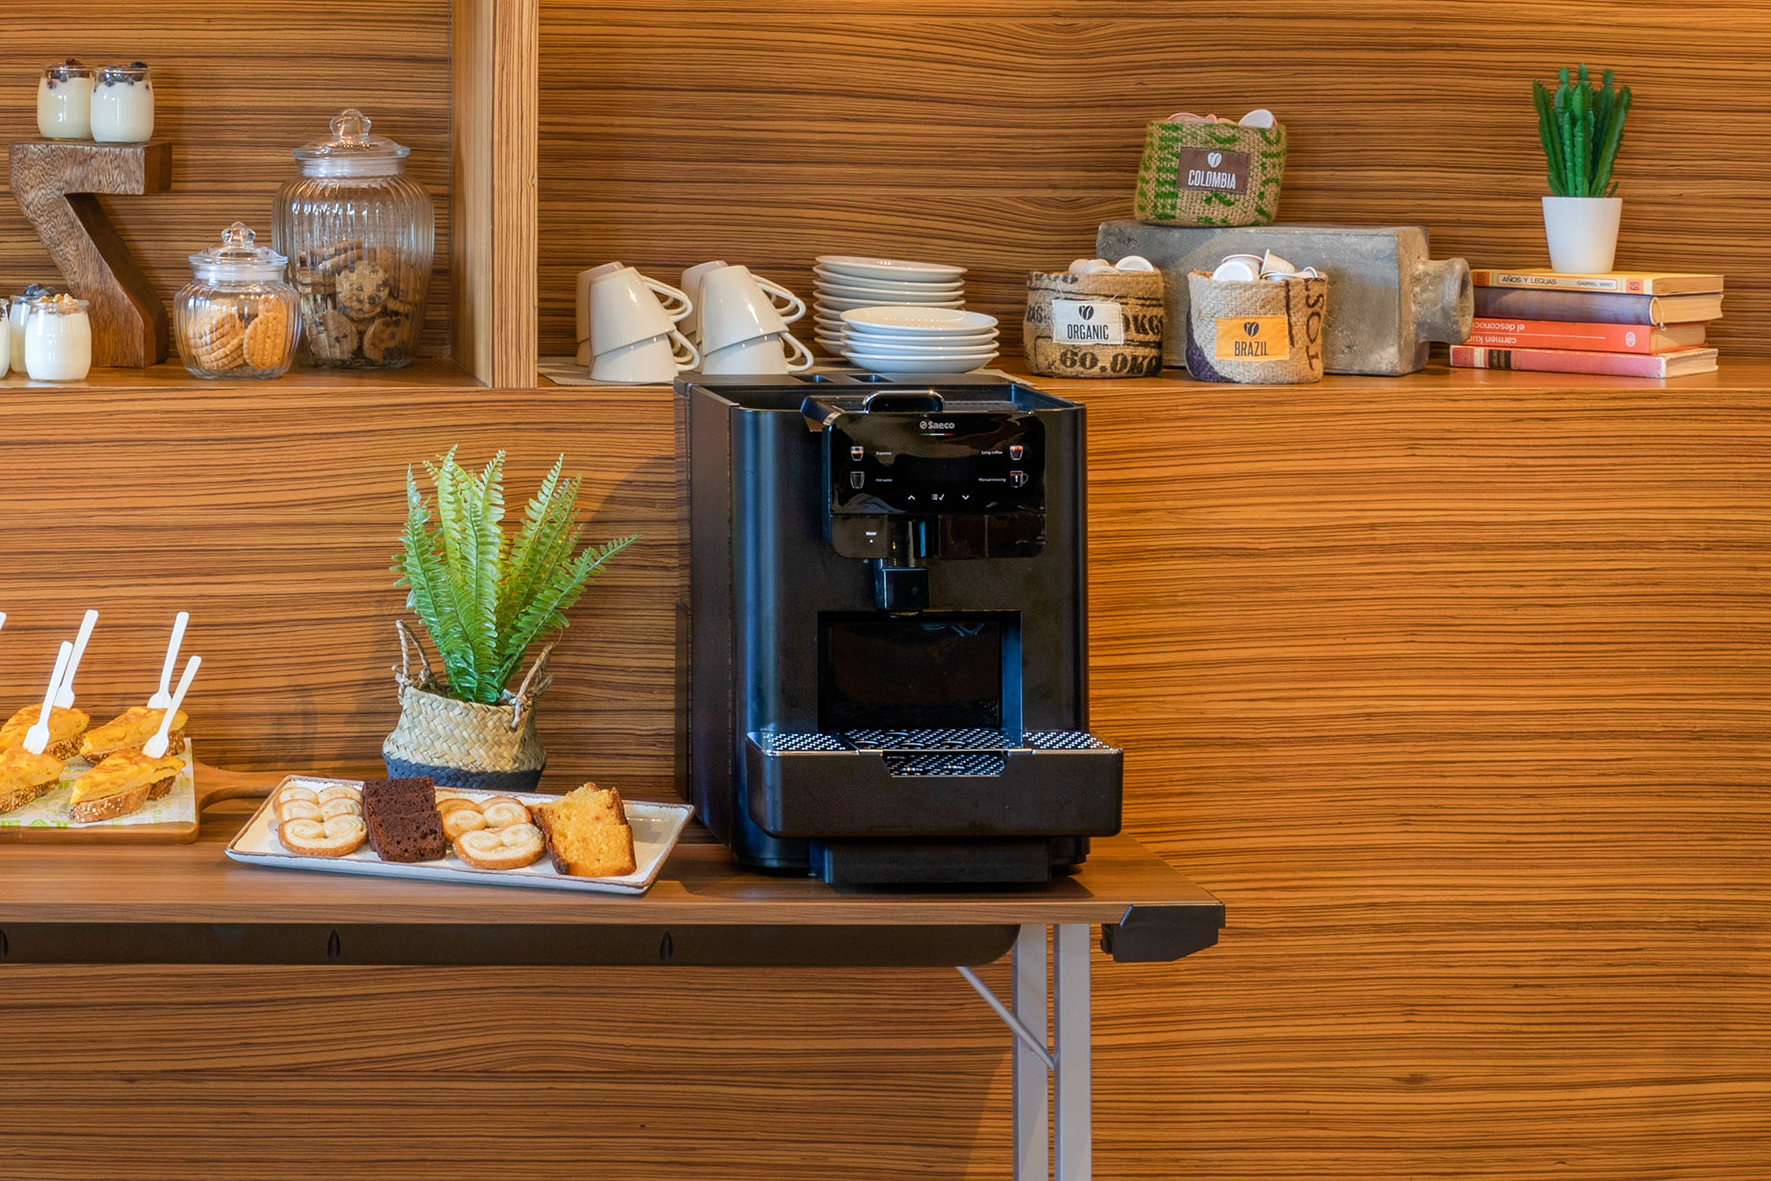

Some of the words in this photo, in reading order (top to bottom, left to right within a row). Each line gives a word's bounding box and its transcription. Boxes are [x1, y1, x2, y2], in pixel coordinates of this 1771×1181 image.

[1187, 169, 1237, 189] COLOMBIA
[1501, 274, 1522, 284] AÑOS
[1523, 276, 1529, 284] Y
[1530, 277, 1557, 285] LEGUAS
[1472, 322, 1517, 331] desconoci
[1517, 323, 1525, 331] el
[1067, 323, 1109, 340] ORGANIC
[1466, 335, 1483, 344] kur
[1484, 336, 1517, 344] carmen
[1234, 341, 1268, 357] BRAZIL
[927, 421, 955, 430] Saeco
